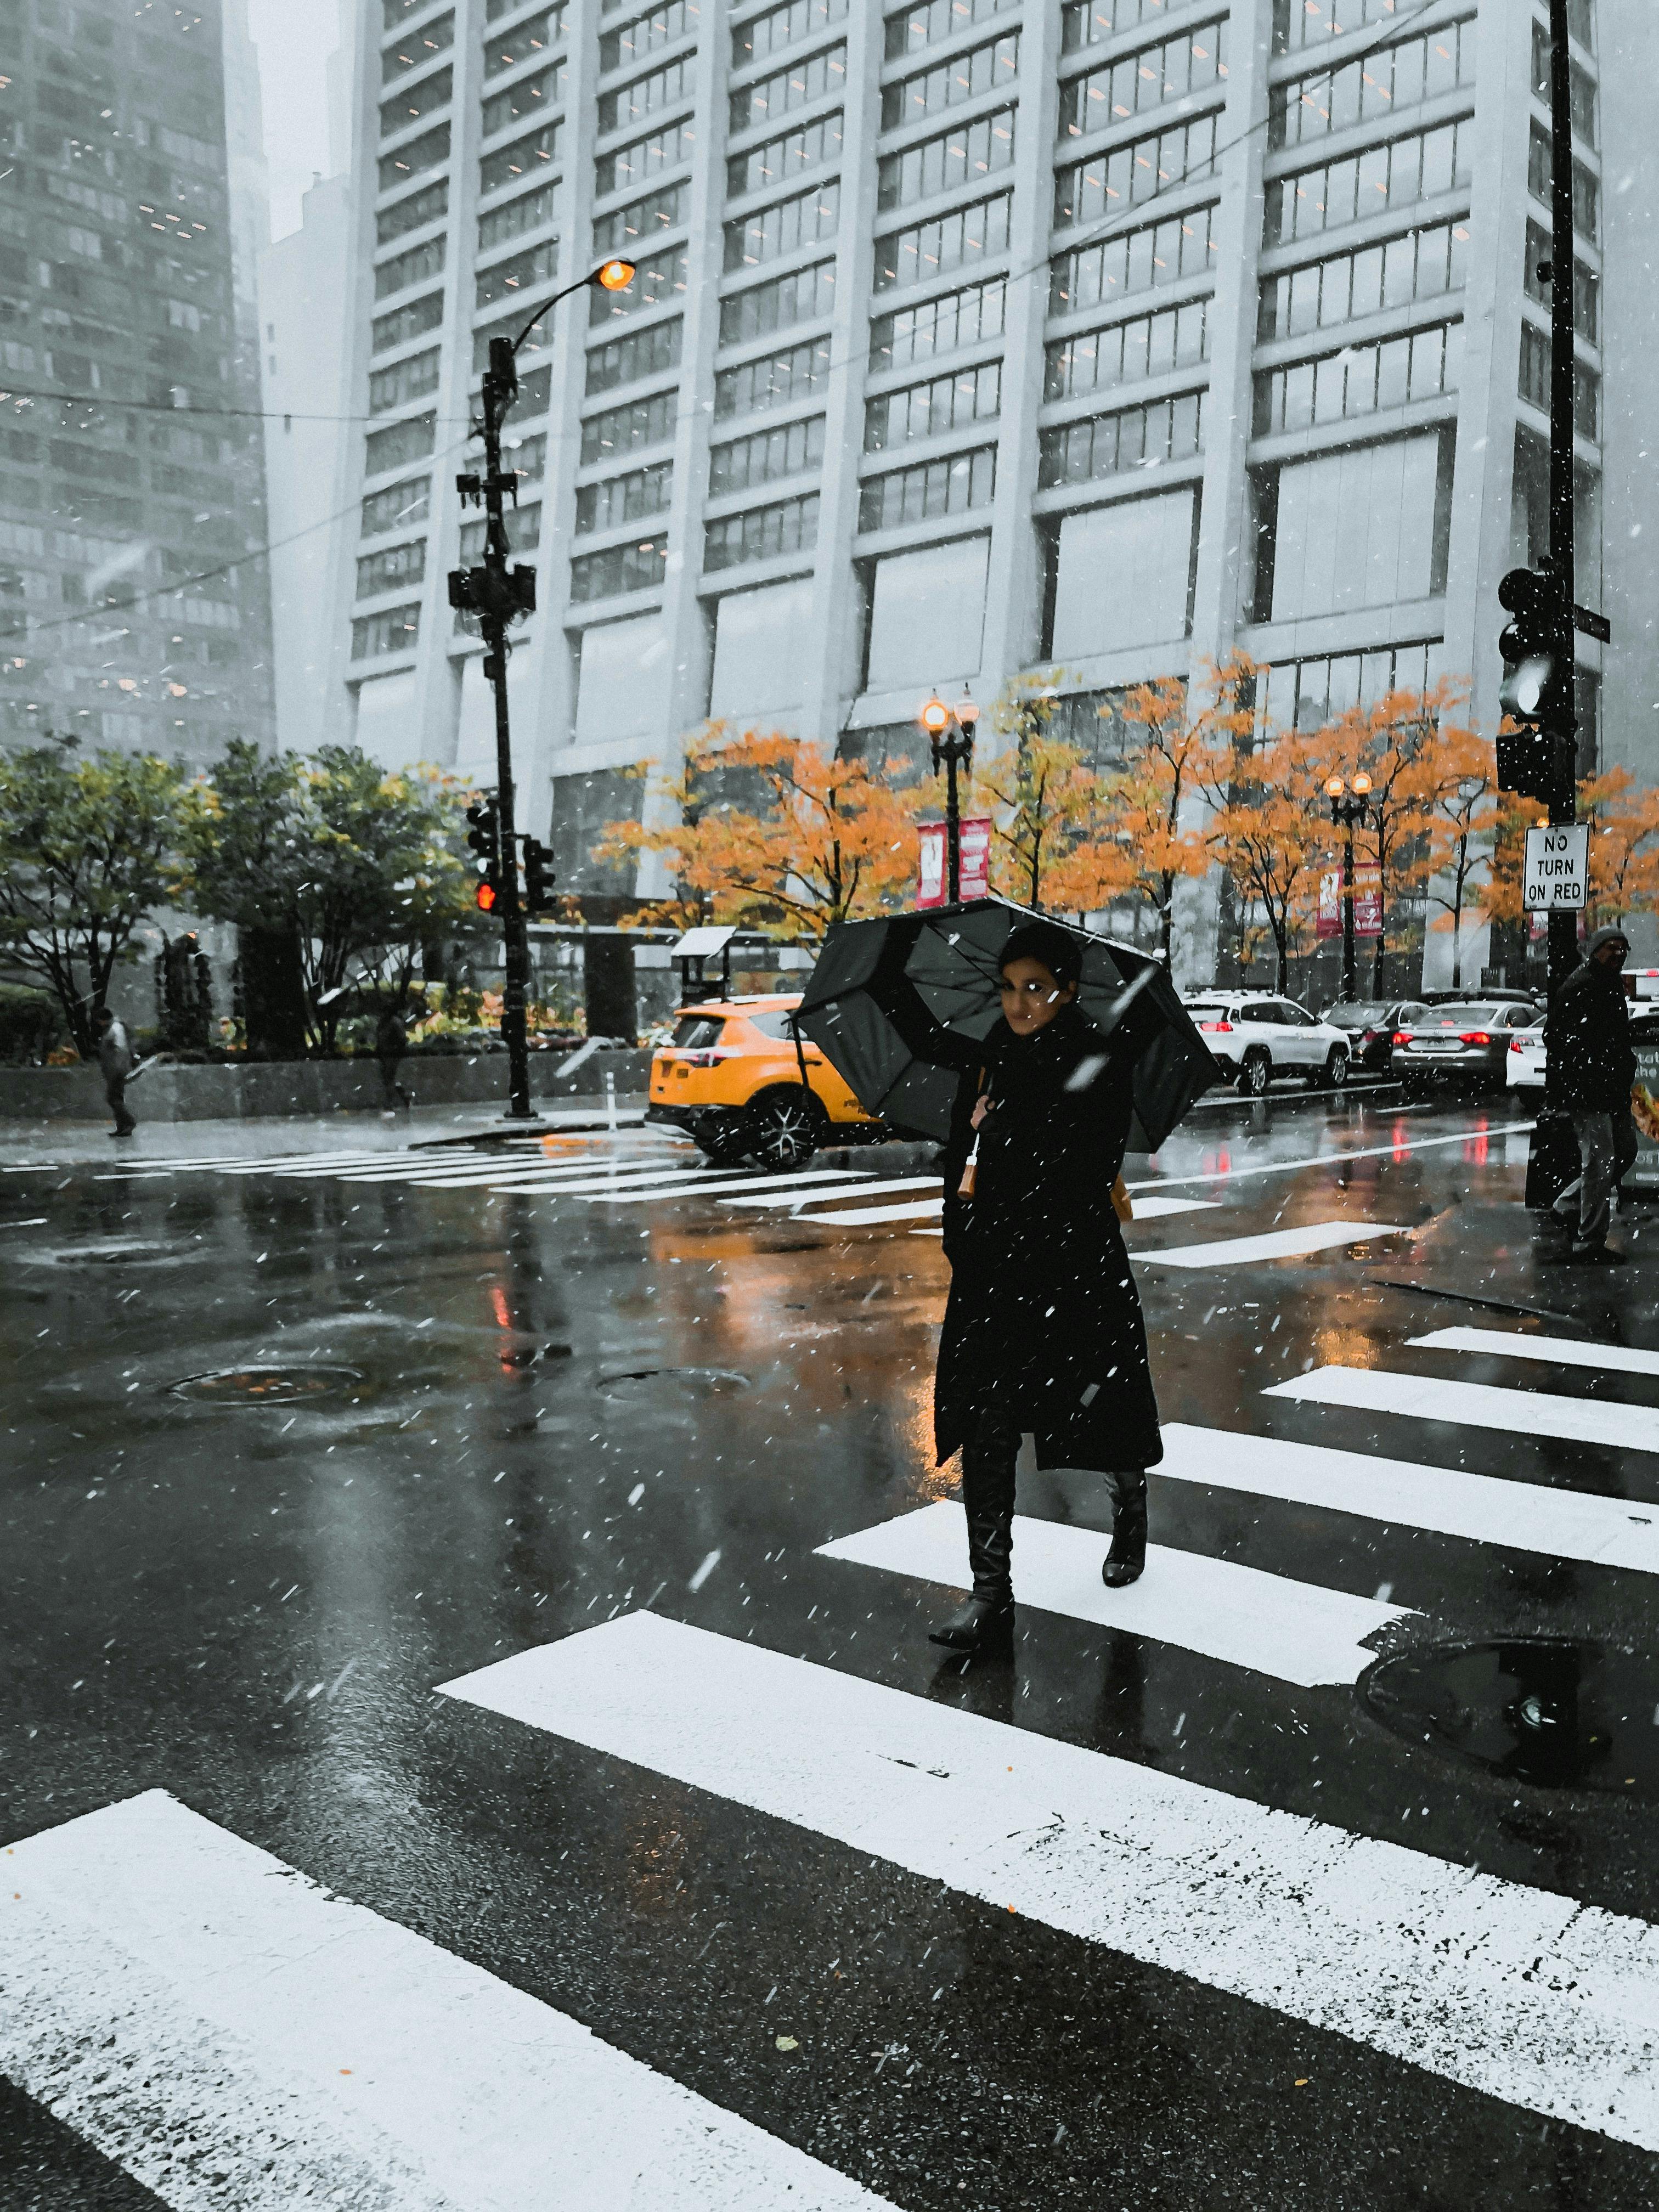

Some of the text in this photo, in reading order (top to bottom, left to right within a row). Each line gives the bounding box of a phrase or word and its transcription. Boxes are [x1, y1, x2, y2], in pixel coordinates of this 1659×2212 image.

[1544, 834, 1568, 853] NO
[1537, 859, 1574, 876] TURN
[1529, 882, 1581, 900] ON RED
